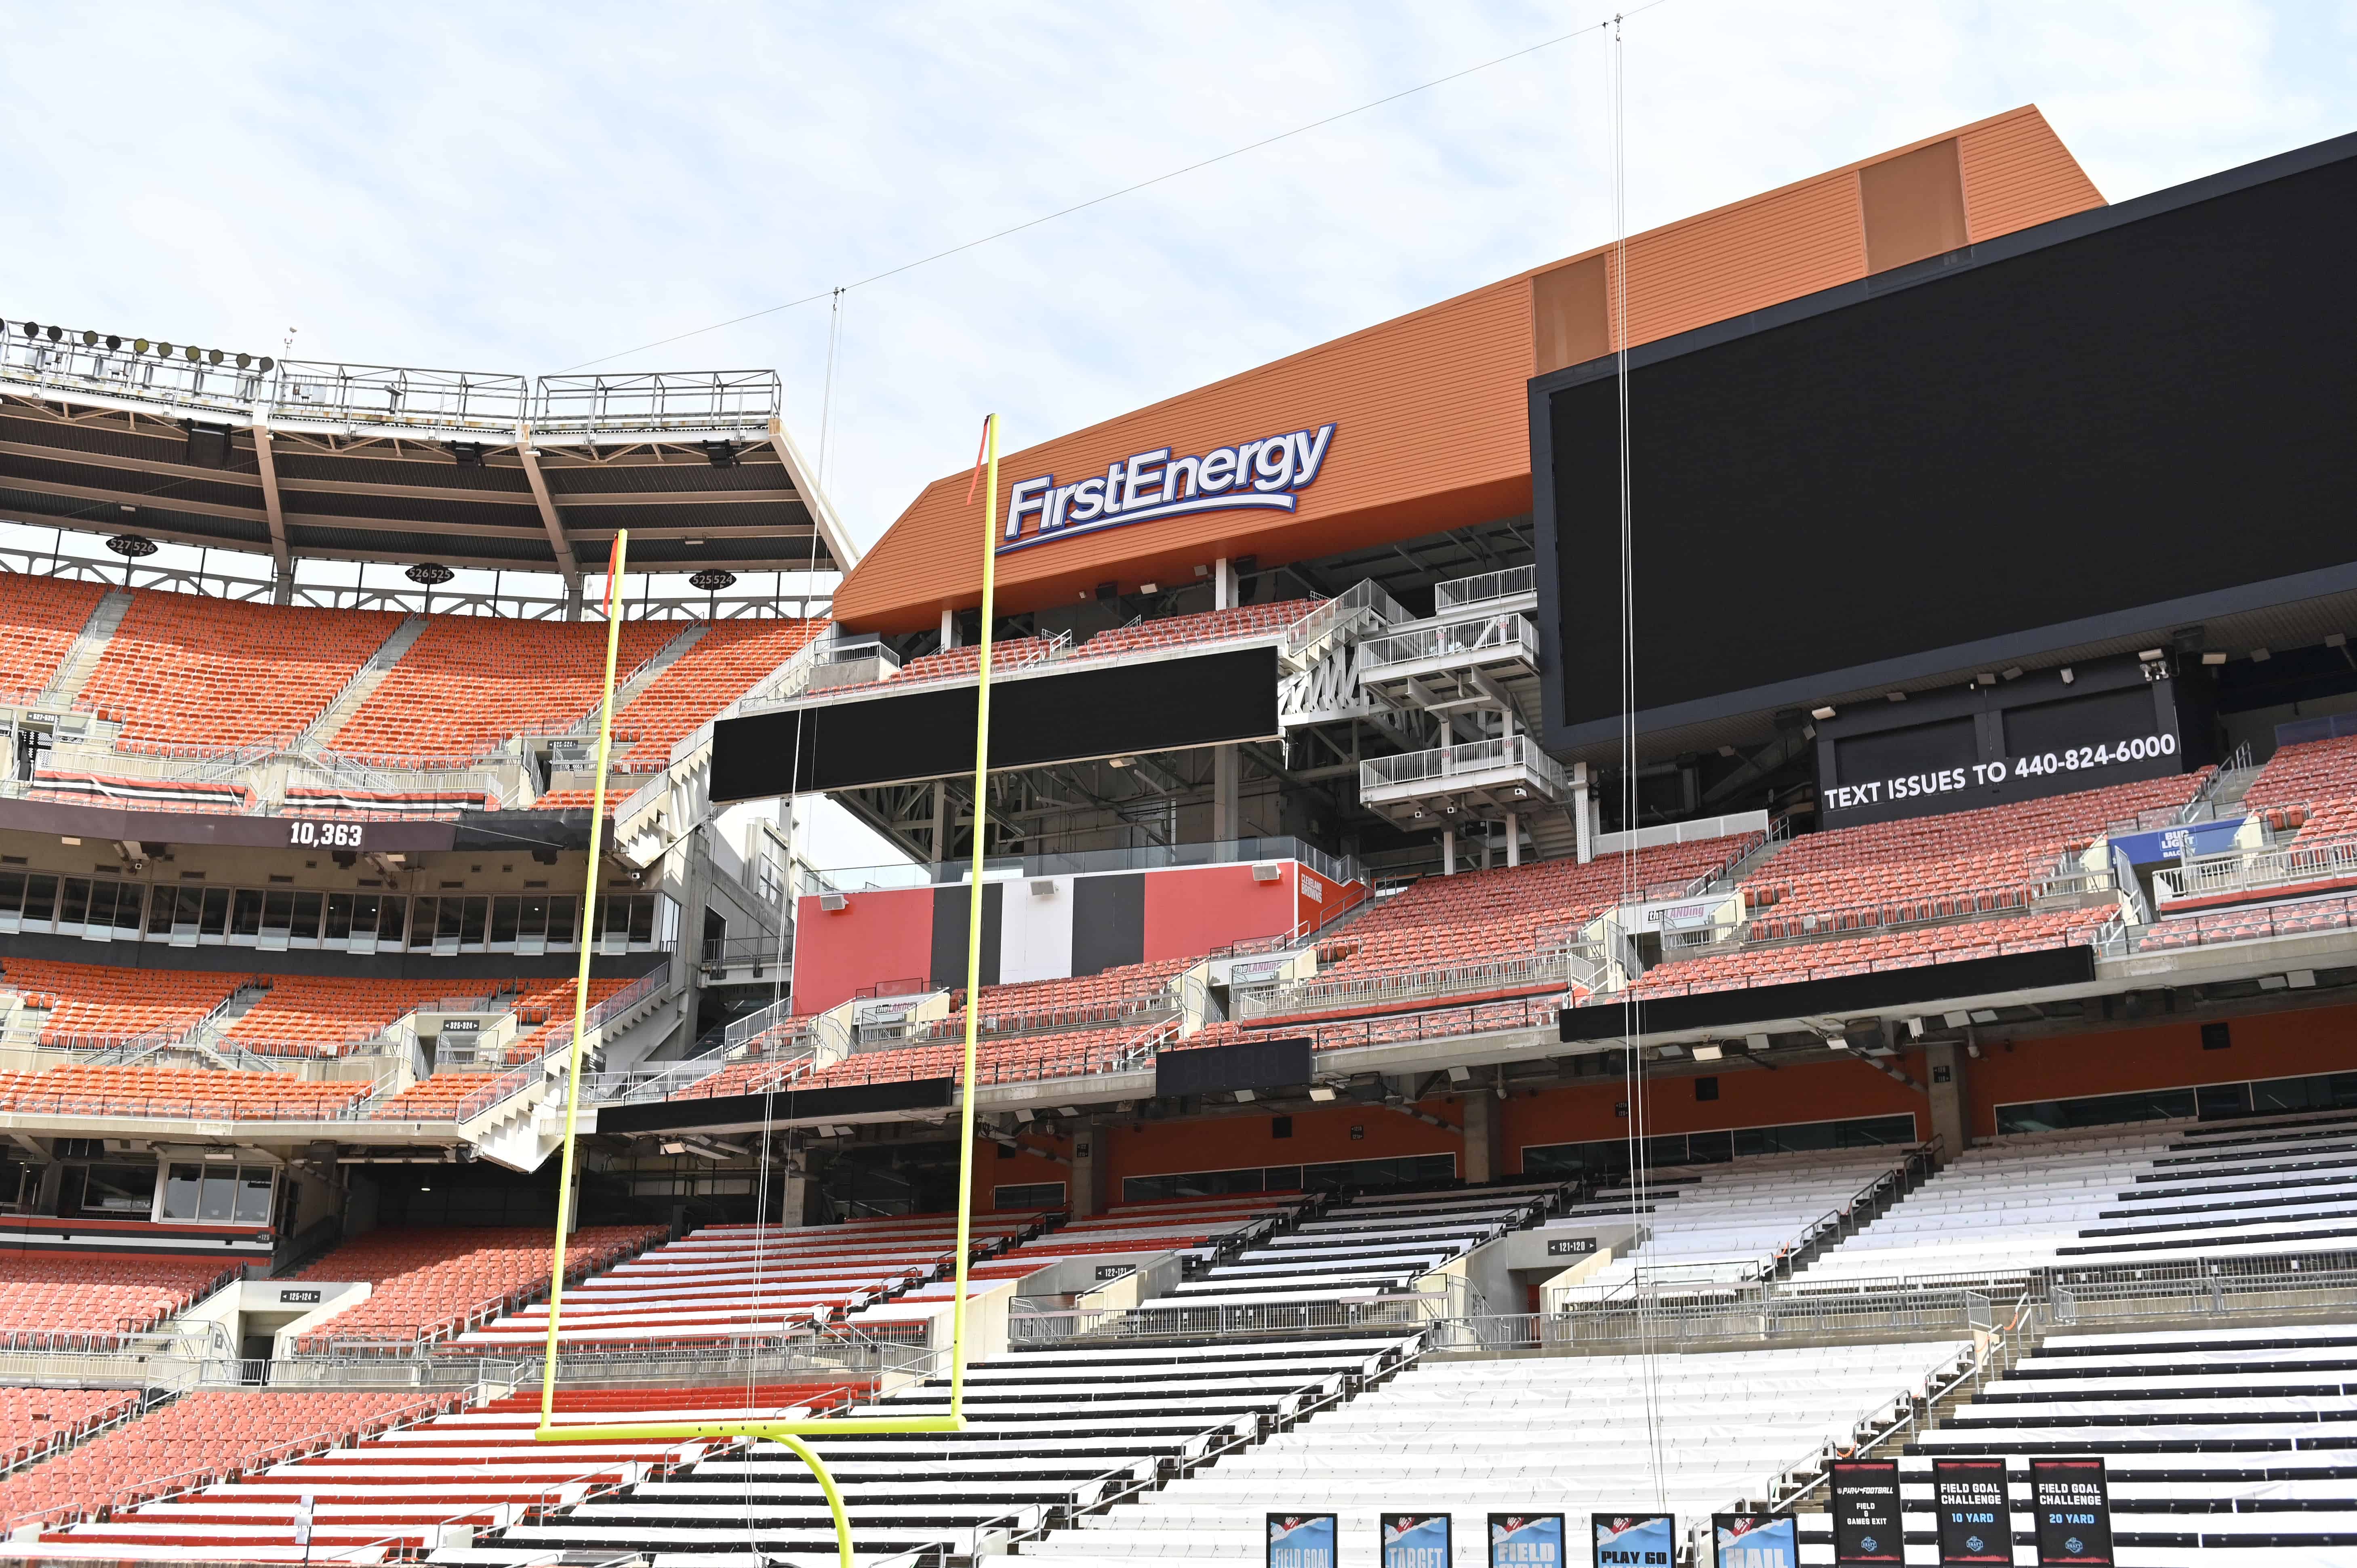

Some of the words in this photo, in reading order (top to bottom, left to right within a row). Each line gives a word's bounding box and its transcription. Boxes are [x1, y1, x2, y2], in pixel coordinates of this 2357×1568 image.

[1004, 423, 1336, 539] FirstEnergy
[109, 539, 131, 550] 527
[133, 542, 154, 552] 526
[408, 568, 429, 578] 526
[431, 570, 450, 579] 525
[692, 575, 712, 584] 525
[713, 575, 733, 584] 524
[1824, 782, 1881, 809] TEXT
[1888, 768, 1966, 799] ISSUES
[1972, 762, 2006, 785] TO
[2015, 734, 2176, 778] 440-824-6000
[290, 822, 362, 848] 10,363
[1301, 873, 1322, 893] CLEVELAND
[1301, 883, 1322, 904] BROWNS
[1940, 1484, 1969, 1493] FIELD
[1972, 1483, 2000, 1493] GOAL
[2039, 1484, 2068, 1493] FIELD
[2071, 1484, 2100, 1494] GOAL
[1941, 1495, 2001, 1504] CHALLENGE
[2040, 1495, 2101, 1505] CHALLENGE
[1952, 1513, 1963, 1522] 10
[1966, 1513, 1993, 1522] YARD
[2049, 1513, 2062, 1523] 20
[2065, 1514, 2094, 1524] YARD
[1275, 1548, 1301, 1568] FIELD
[1304, 1548, 1329, 1568] GOAL
[1389, 1548, 1443, 1568] TARGET
[1498, 1543, 1555, 1562] FIELD
[1601, 1551, 1640, 1564] PLAY
[1645, 1552, 1667, 1564] 60
[1726, 1548, 1789, 1568] HAIL
